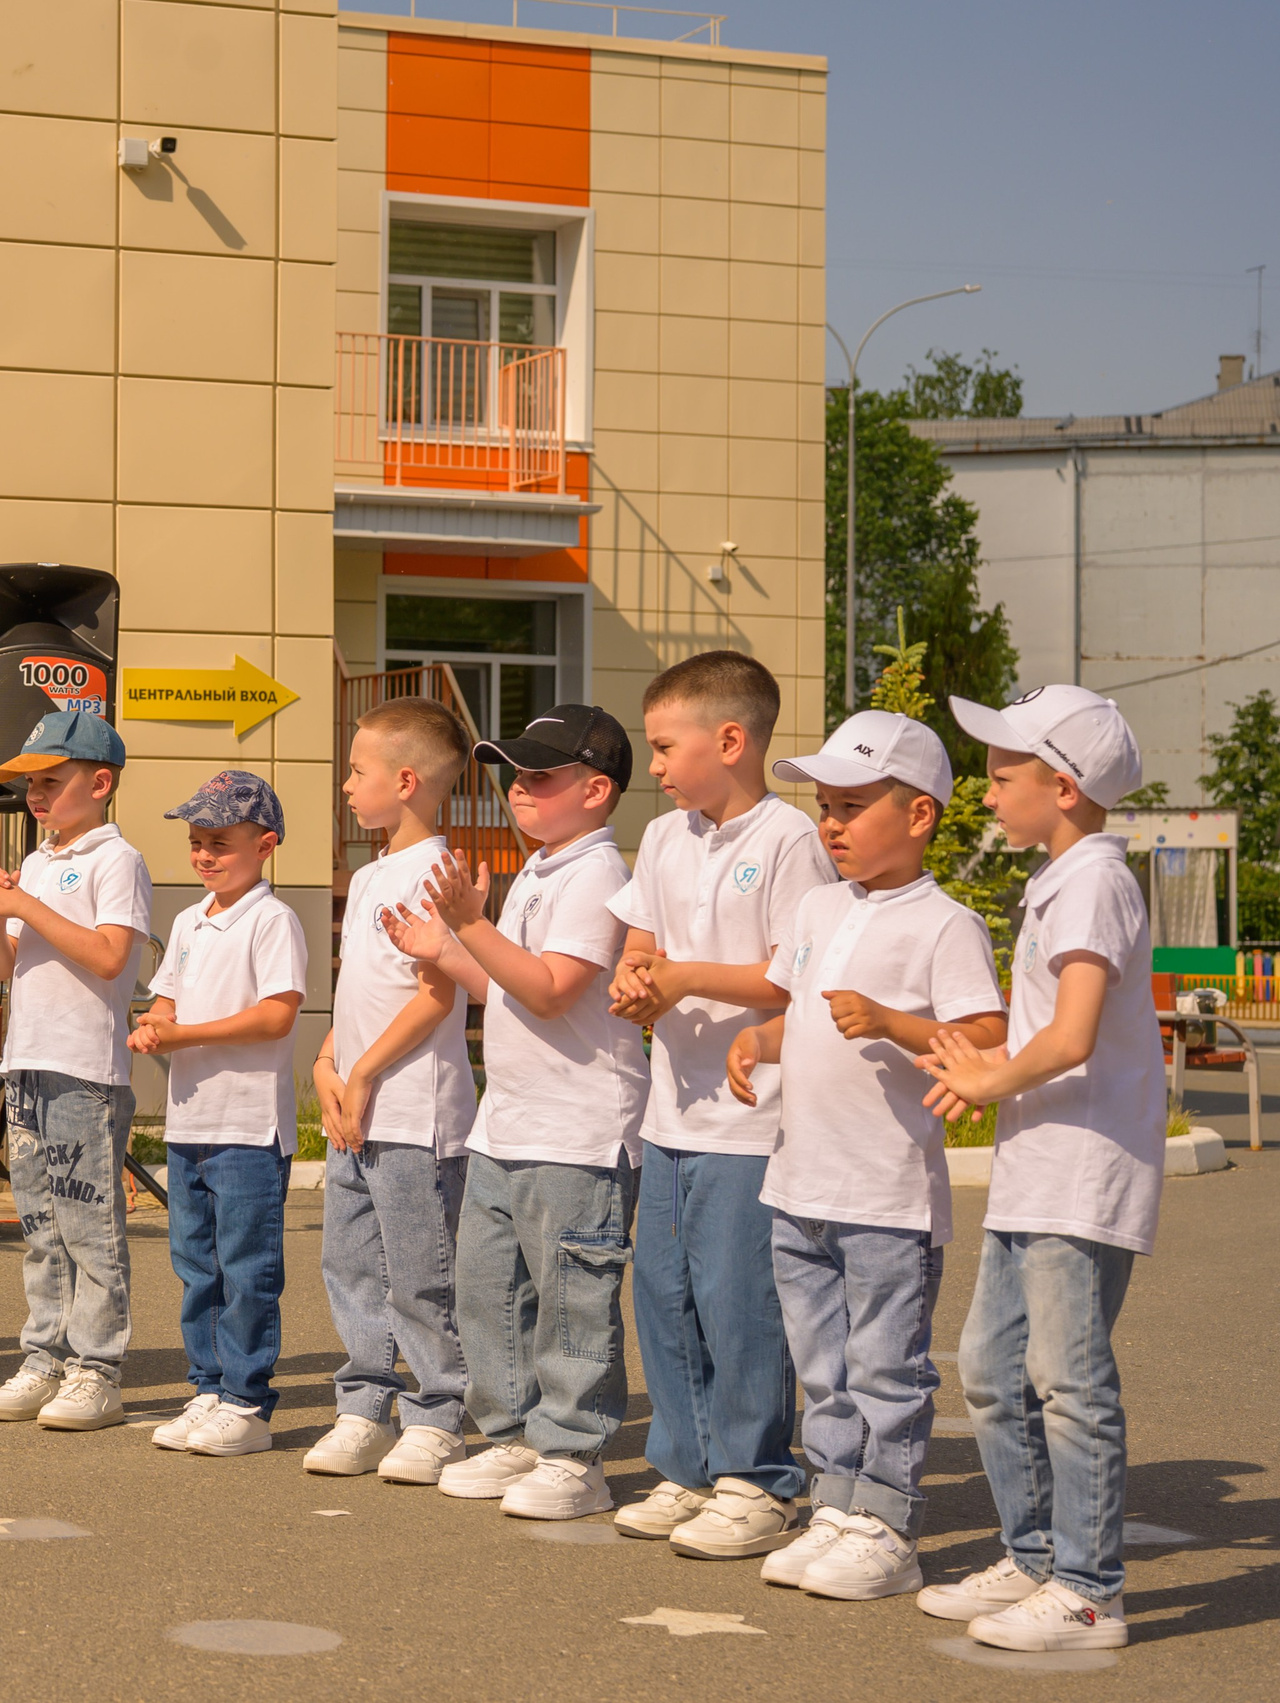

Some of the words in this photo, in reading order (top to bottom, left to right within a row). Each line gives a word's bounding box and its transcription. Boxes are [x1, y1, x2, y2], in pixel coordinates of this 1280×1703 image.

[20, 662, 89, 688] 1000
[49, 687, 80, 695] WATTS
[128, 687, 236, 702] ЦЕНТРАЛЬНЫЙ
[240, 690, 278, 704] ВХОД
[67, 698, 101, 714] MP3
